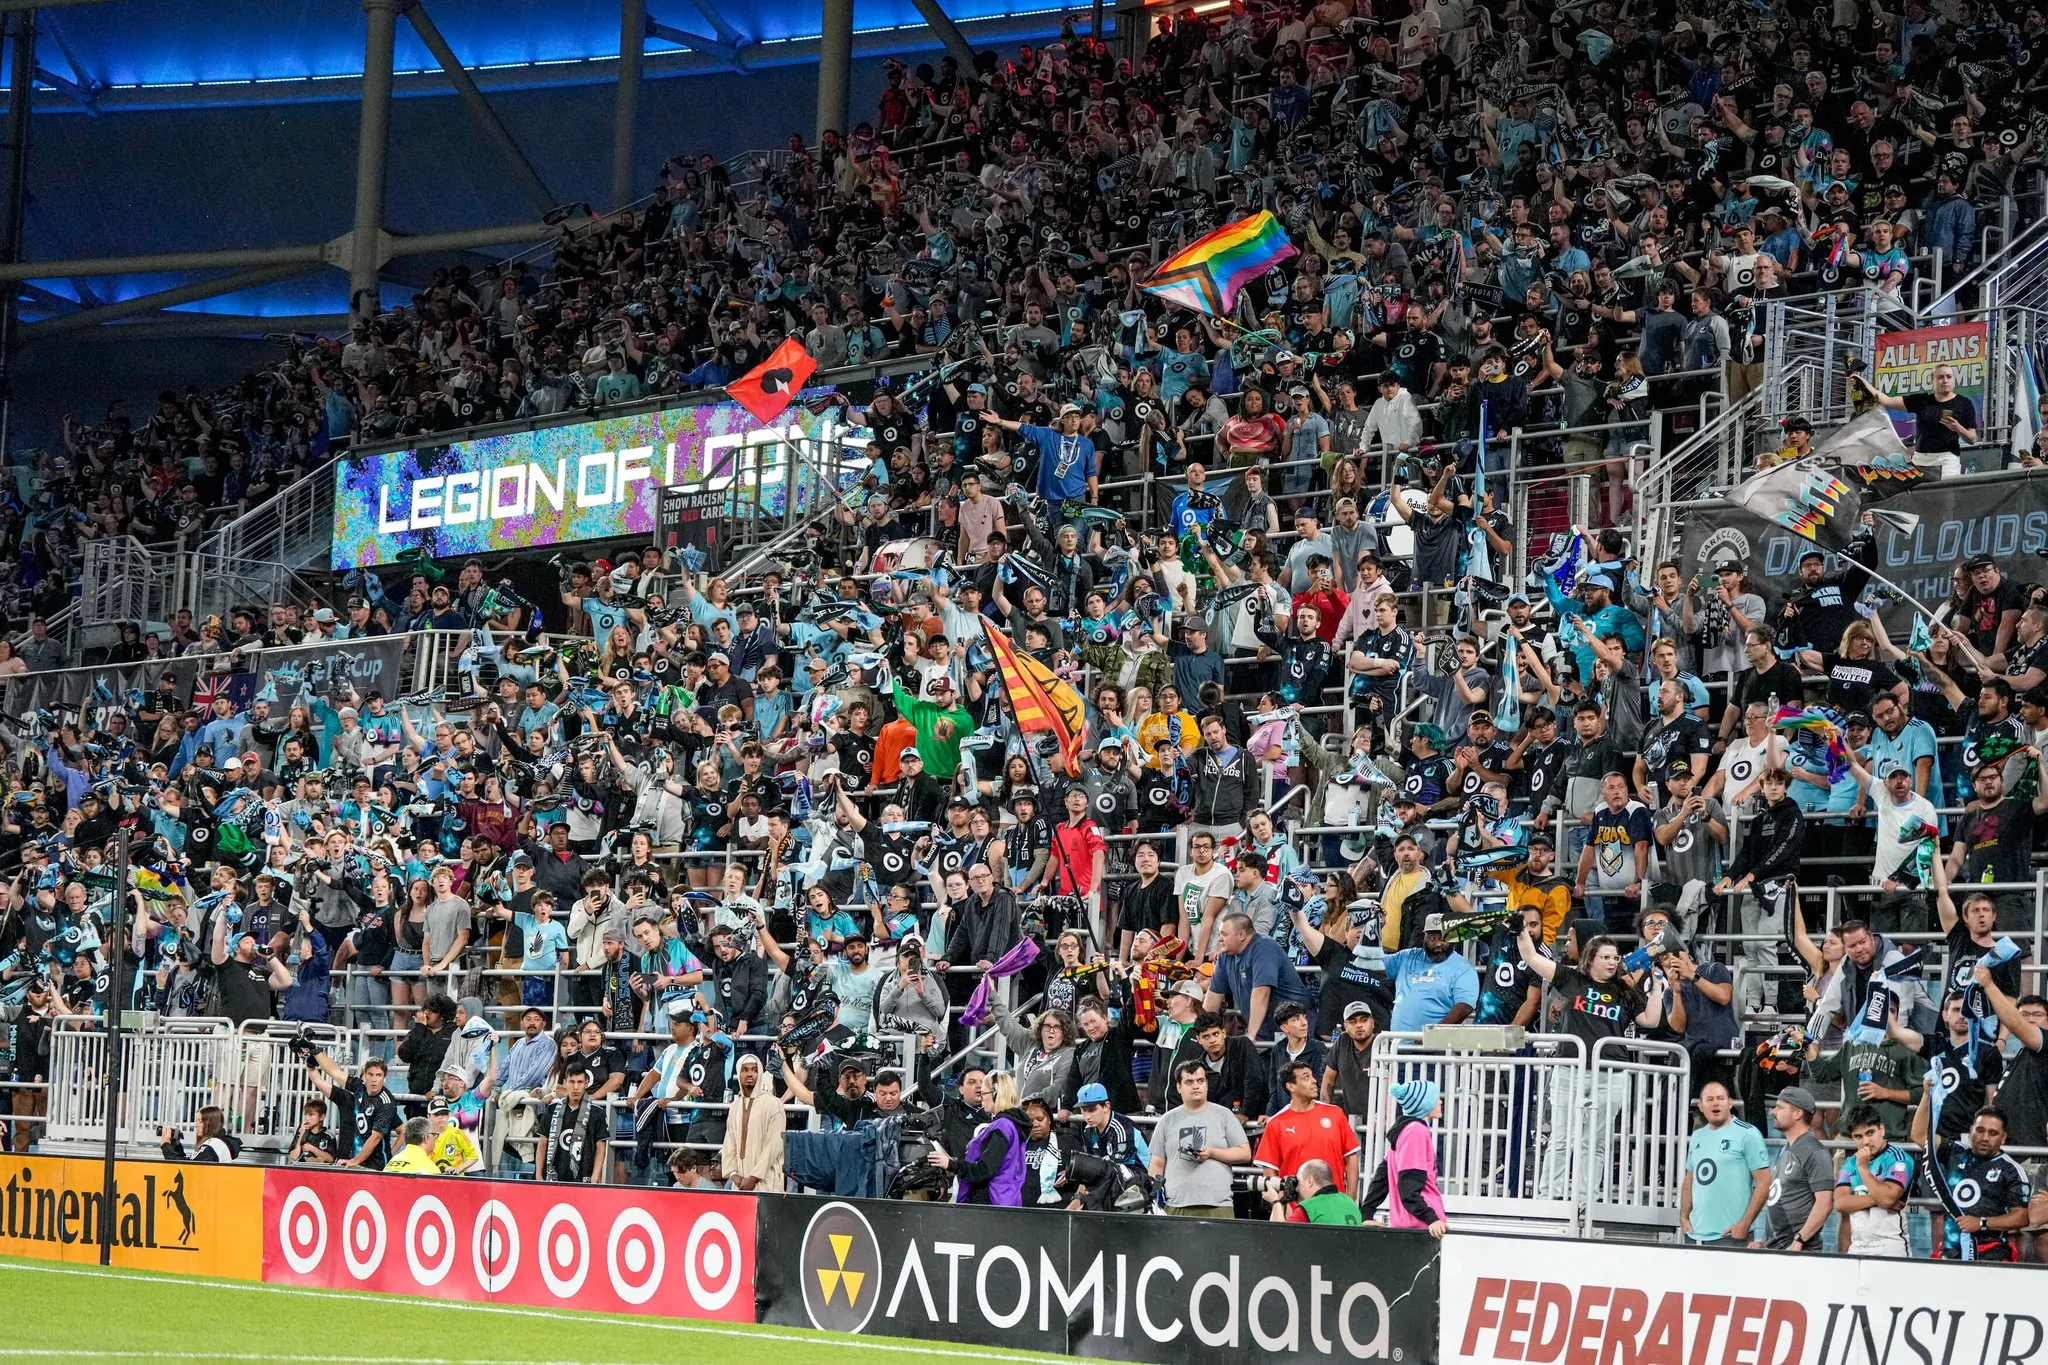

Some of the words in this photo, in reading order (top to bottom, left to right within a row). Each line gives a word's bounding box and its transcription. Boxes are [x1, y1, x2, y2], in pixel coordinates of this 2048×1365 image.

[1880, 344, 1920, 368] ALL
[1926, 335, 1981, 363] FANS
[1878, 363, 1983, 396] WELCME
[379, 459, 567, 534] LEGION
[576, 446, 653, 507] OF
[663, 496, 690, 512] SHOW
[691, 490, 726, 506] RACISM
[662, 511, 680, 525] THE
[681, 509, 700, 522] RED
[700, 506, 725, 520] CARD
[1886, 511, 2048, 567] CLOUDS
[1340, 971, 1369, 984] UNITED
[1370, 977, 1380, 987] FC
[1587, 987, 1612, 1003] be
[1573, 995, 1621, 1021] kind
[1866, 991, 1886, 1022] LEGION
[9, 1024, 18, 1062] MNUFC
[1848, 1053, 1876, 1072] MICHIGAN
[1876, 1055, 1897, 1077] STATE
[547, 1101, 564, 1166] MINNESOT
[0, 1167, 157, 1249] tinental
[1459, 1277, 1808, 1365] FEDERATED
